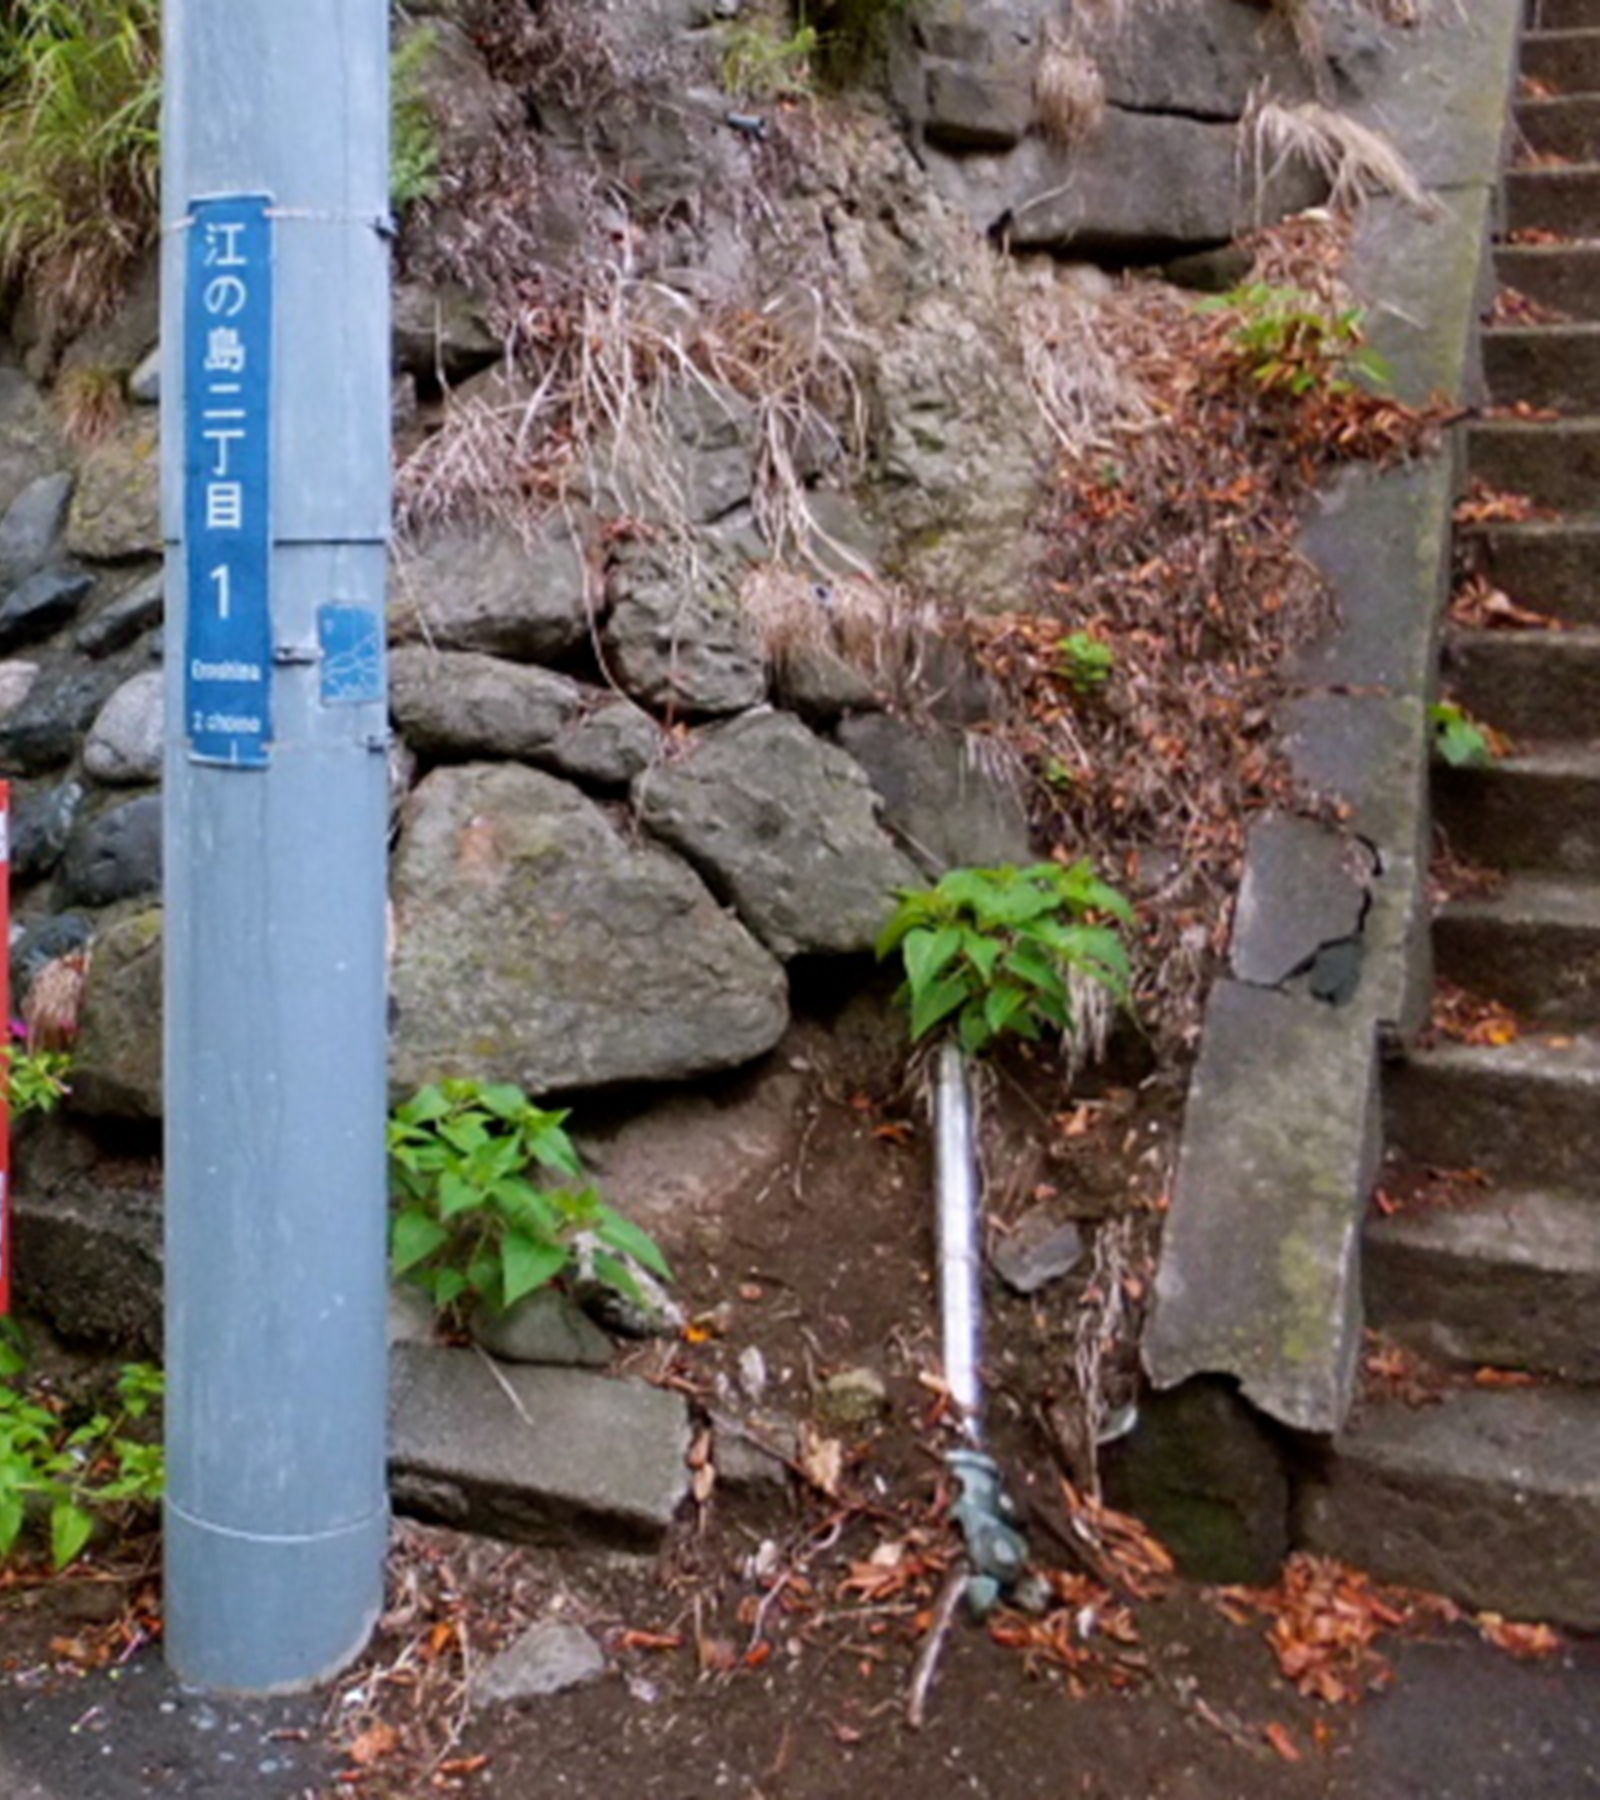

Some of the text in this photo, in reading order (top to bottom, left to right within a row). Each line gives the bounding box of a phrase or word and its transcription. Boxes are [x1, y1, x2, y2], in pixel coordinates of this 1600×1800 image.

[203, 222, 247, 529] 江の島二丁目
